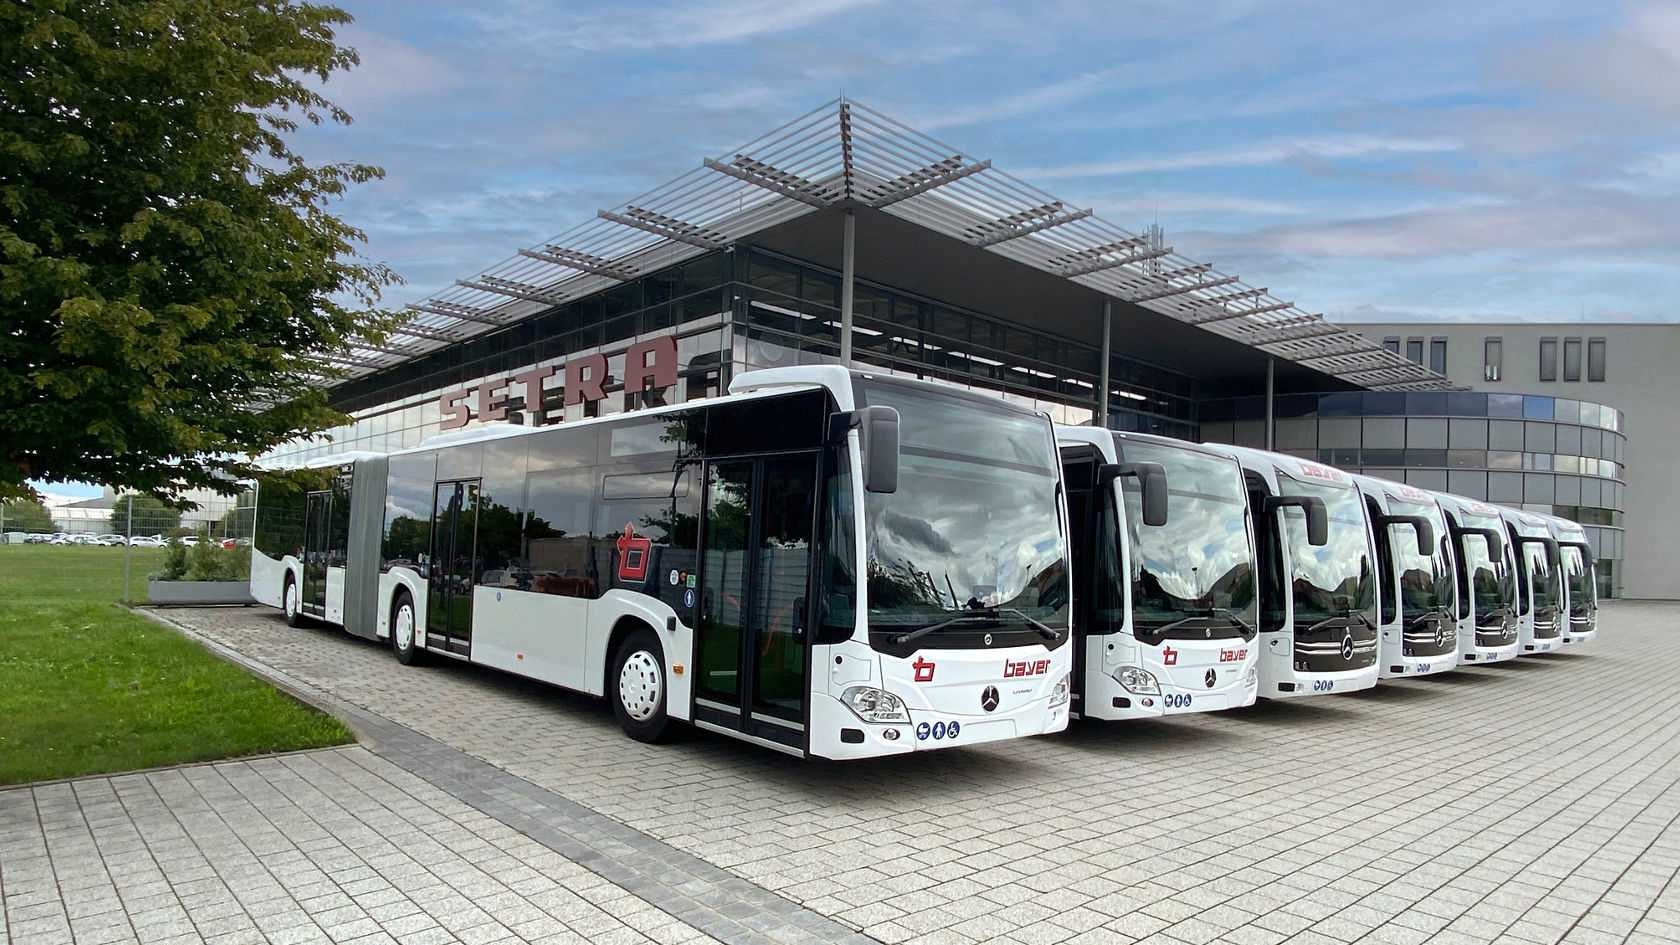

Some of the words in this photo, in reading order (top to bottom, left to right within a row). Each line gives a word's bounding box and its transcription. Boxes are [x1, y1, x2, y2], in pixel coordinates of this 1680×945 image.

[439, 335, 678, 430] SETRA
[1219, 648, 1248, 662] bayer
[1003, 658, 1051, 678] bayer
